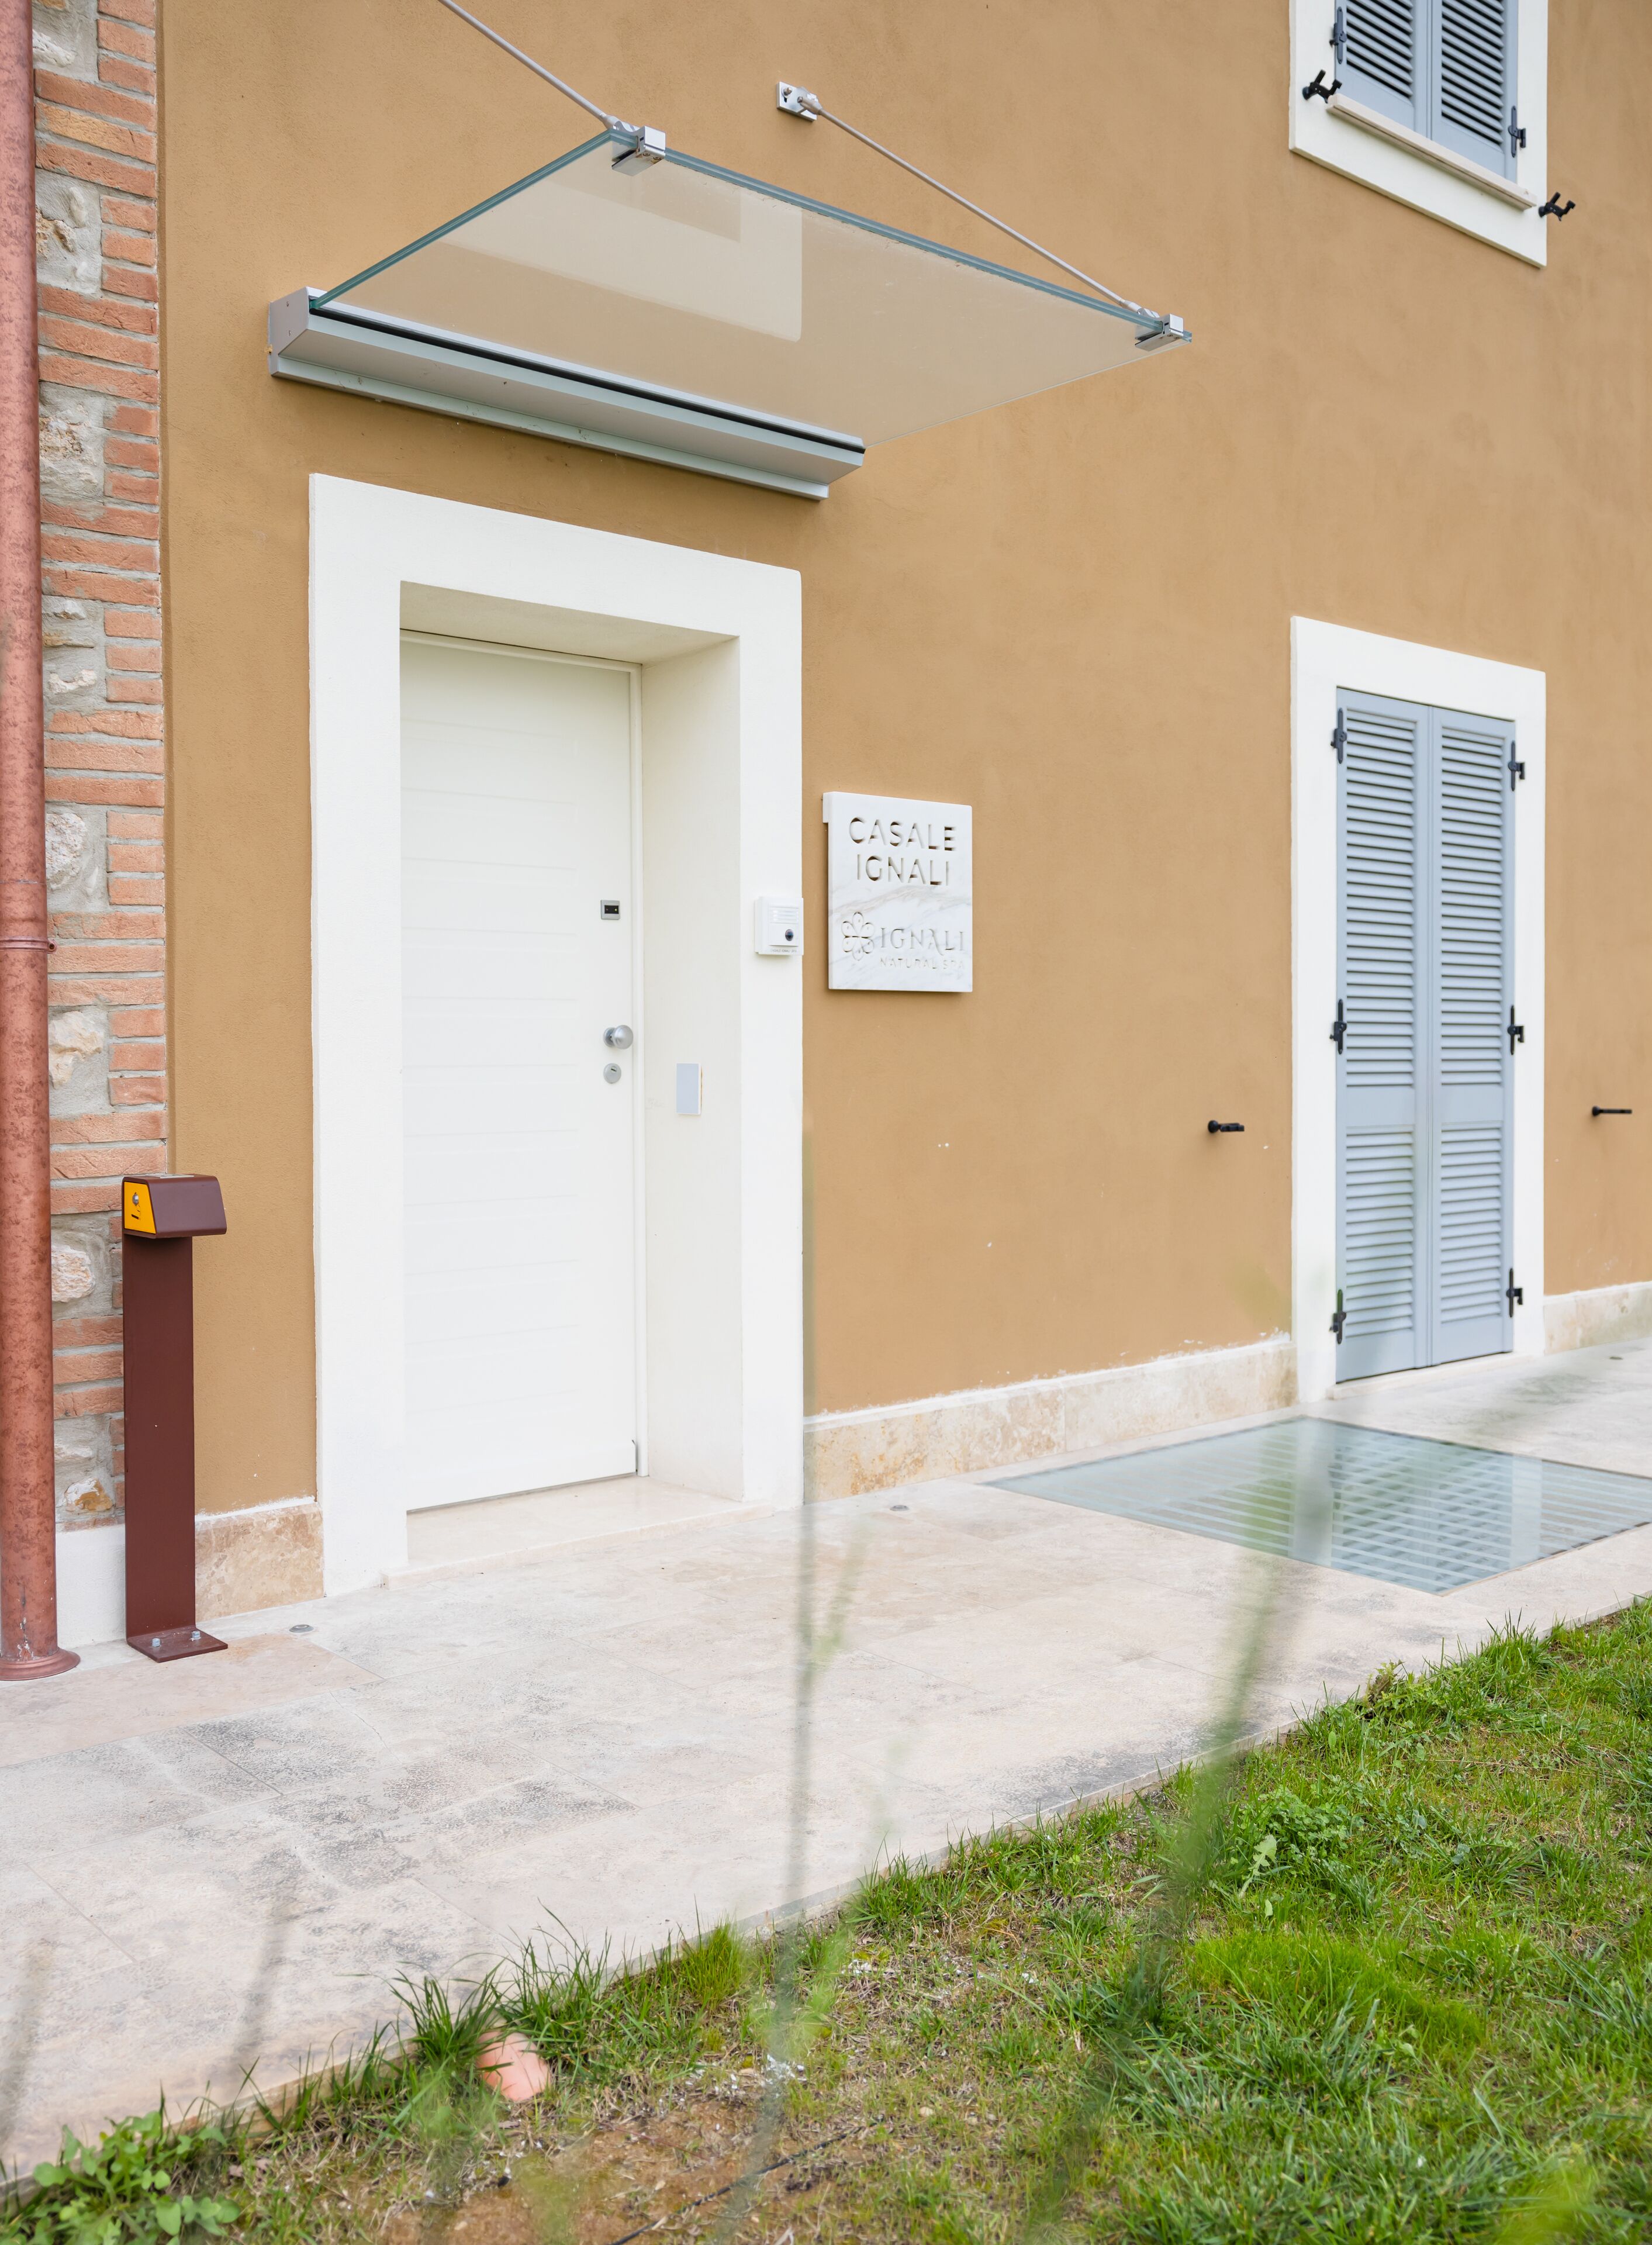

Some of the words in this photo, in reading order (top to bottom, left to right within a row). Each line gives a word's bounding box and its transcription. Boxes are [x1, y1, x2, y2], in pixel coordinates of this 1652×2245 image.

[849, 817, 956, 851] CASALE
[857, 854, 950, 886] IGNALI
[880, 927, 964, 955] IGNALI
[880, 958, 936, 969] NATURAL
[943, 959, 965, 970] SPA
